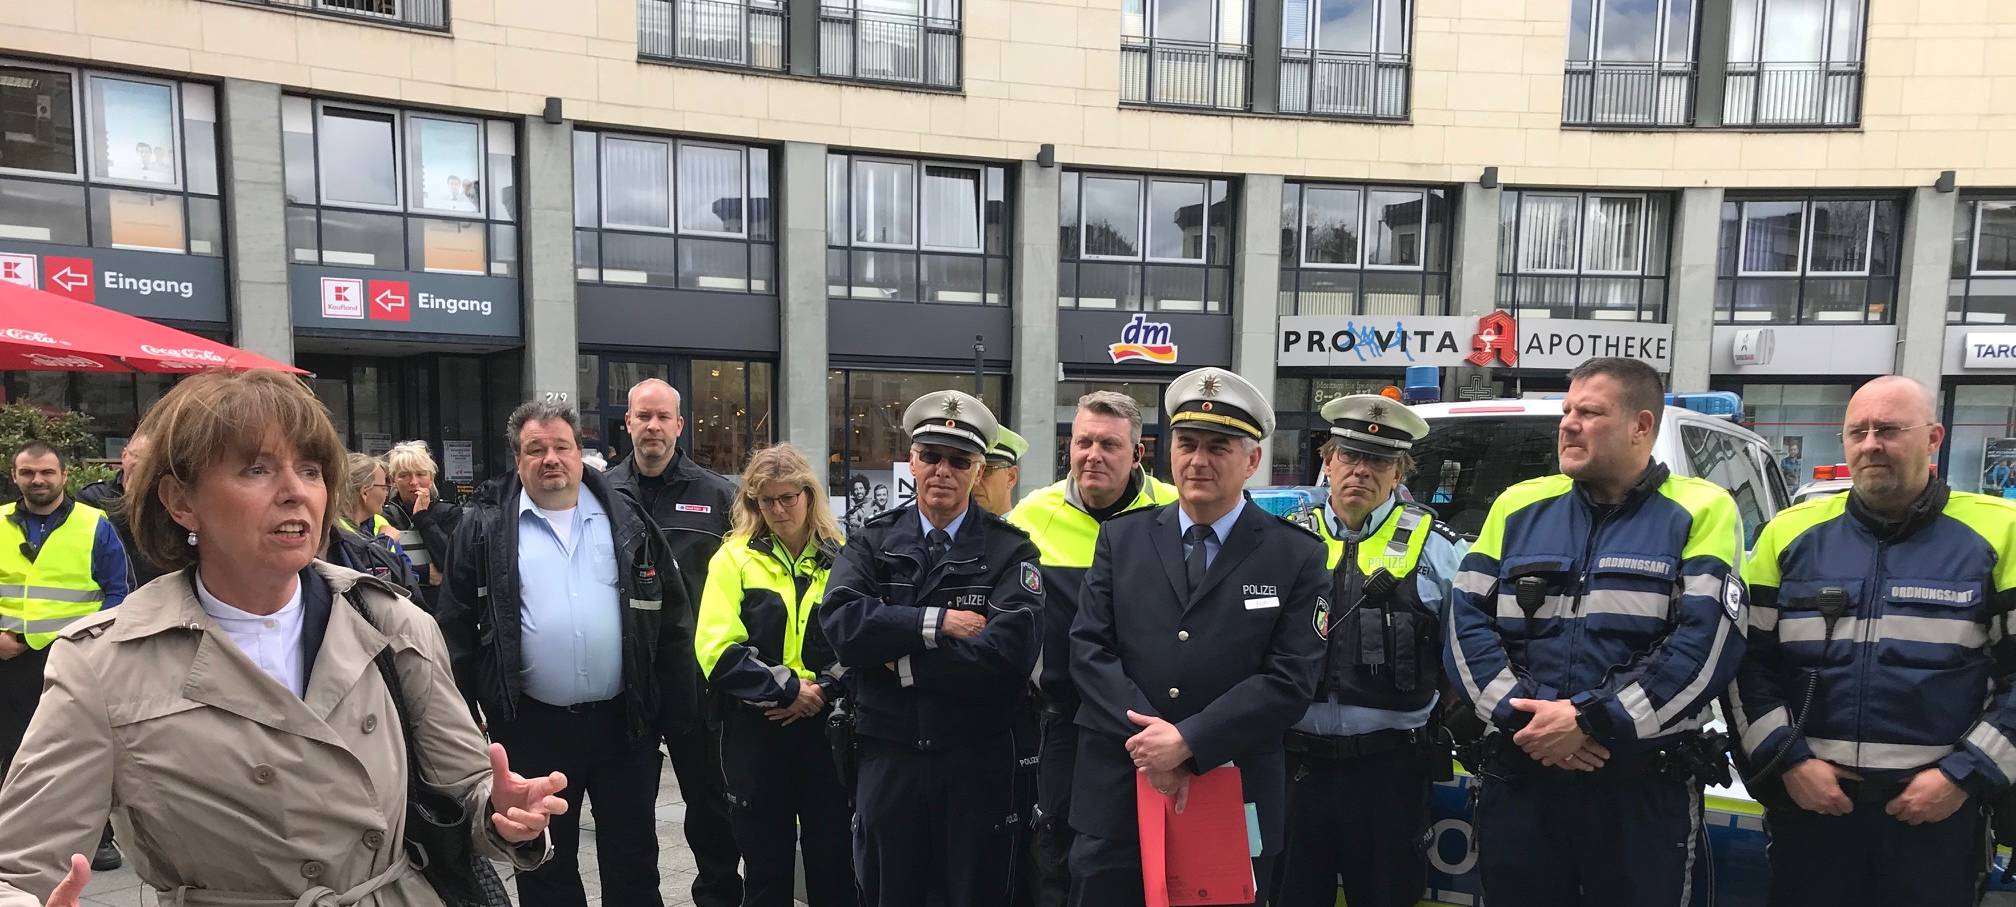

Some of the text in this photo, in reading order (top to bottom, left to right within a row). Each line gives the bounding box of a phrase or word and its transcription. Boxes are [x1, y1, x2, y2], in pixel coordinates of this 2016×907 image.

[104, 270, 193, 299] Eingang
[418, 292, 493, 316] Eingang
[1123, 316, 1169, 345] dm
[1283, 330, 1459, 353] PRO VITA
[1525, 332, 1667, 360] APOTHEKE
[1598, 556, 1671, 575] ORDNUNGSAMT
[1242, 584, 1277, 596] POLIZEI
[1891, 586, 1974, 603] ORDNUNGSAMT
